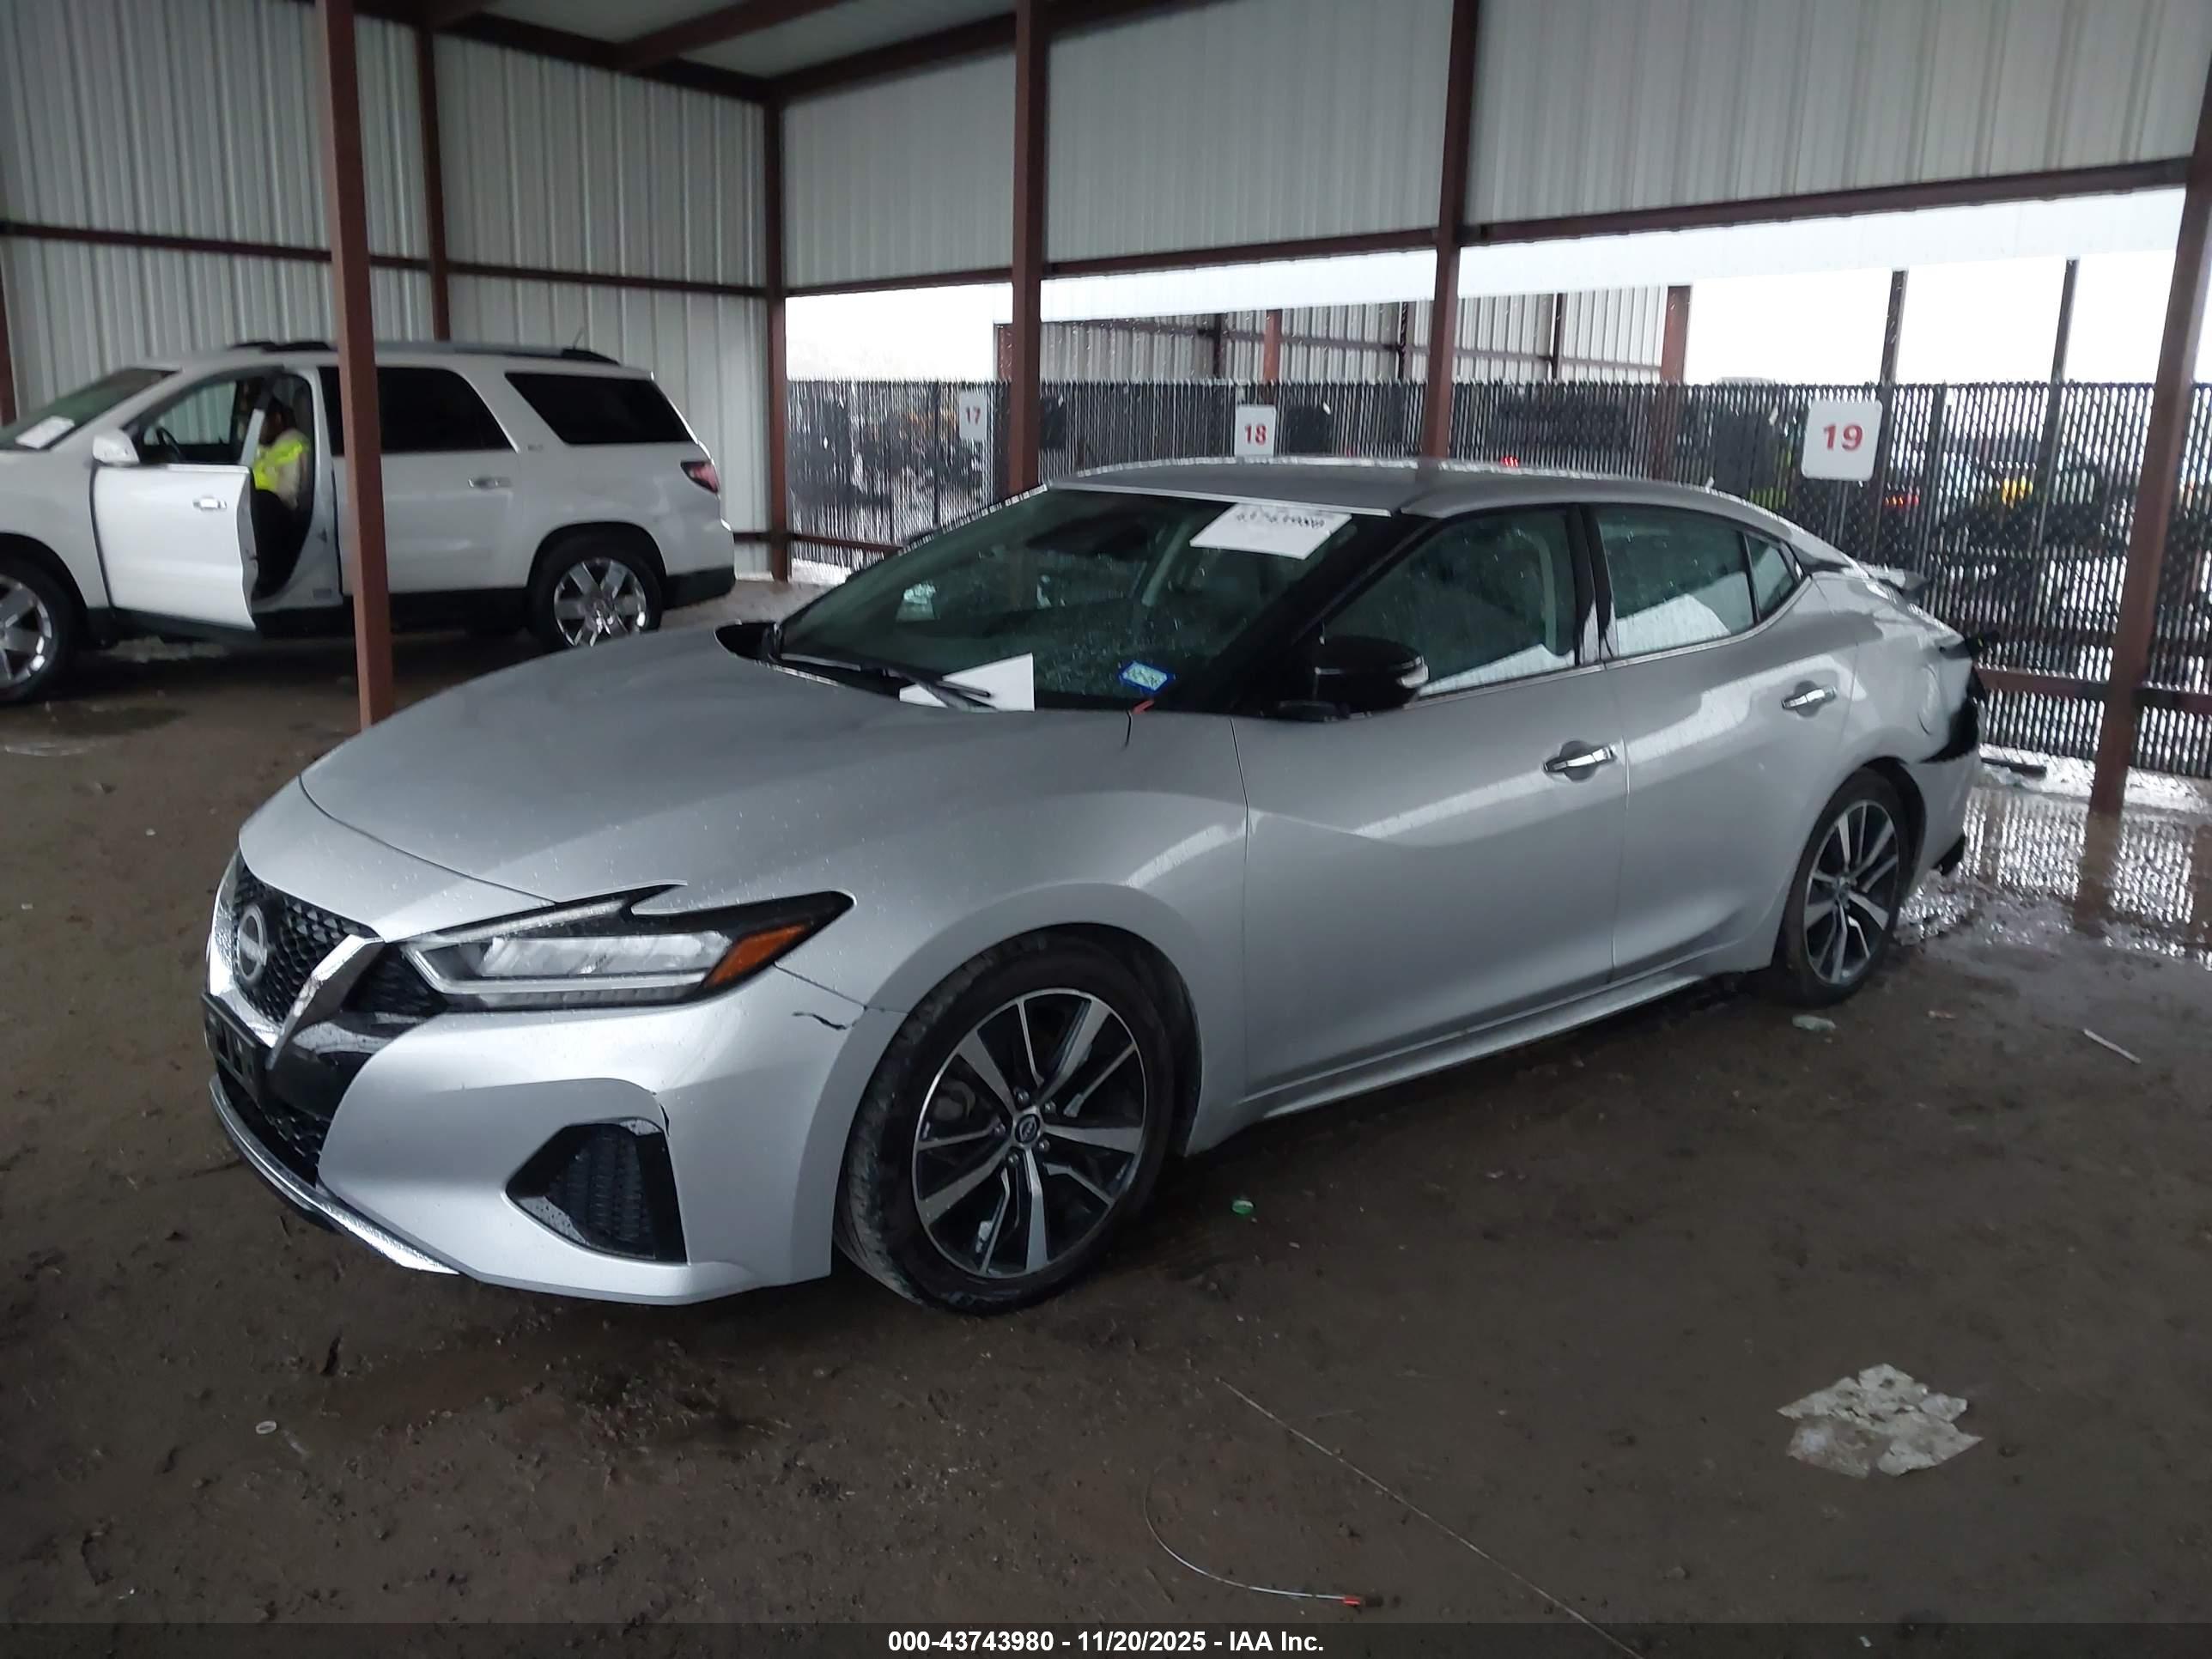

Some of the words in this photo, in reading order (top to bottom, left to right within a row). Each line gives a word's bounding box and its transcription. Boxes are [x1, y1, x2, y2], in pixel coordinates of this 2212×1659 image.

[966, 406, 981, 424] 17
[1245, 424, 1267, 446] 18
[1823, 423, 1863, 451] 19
